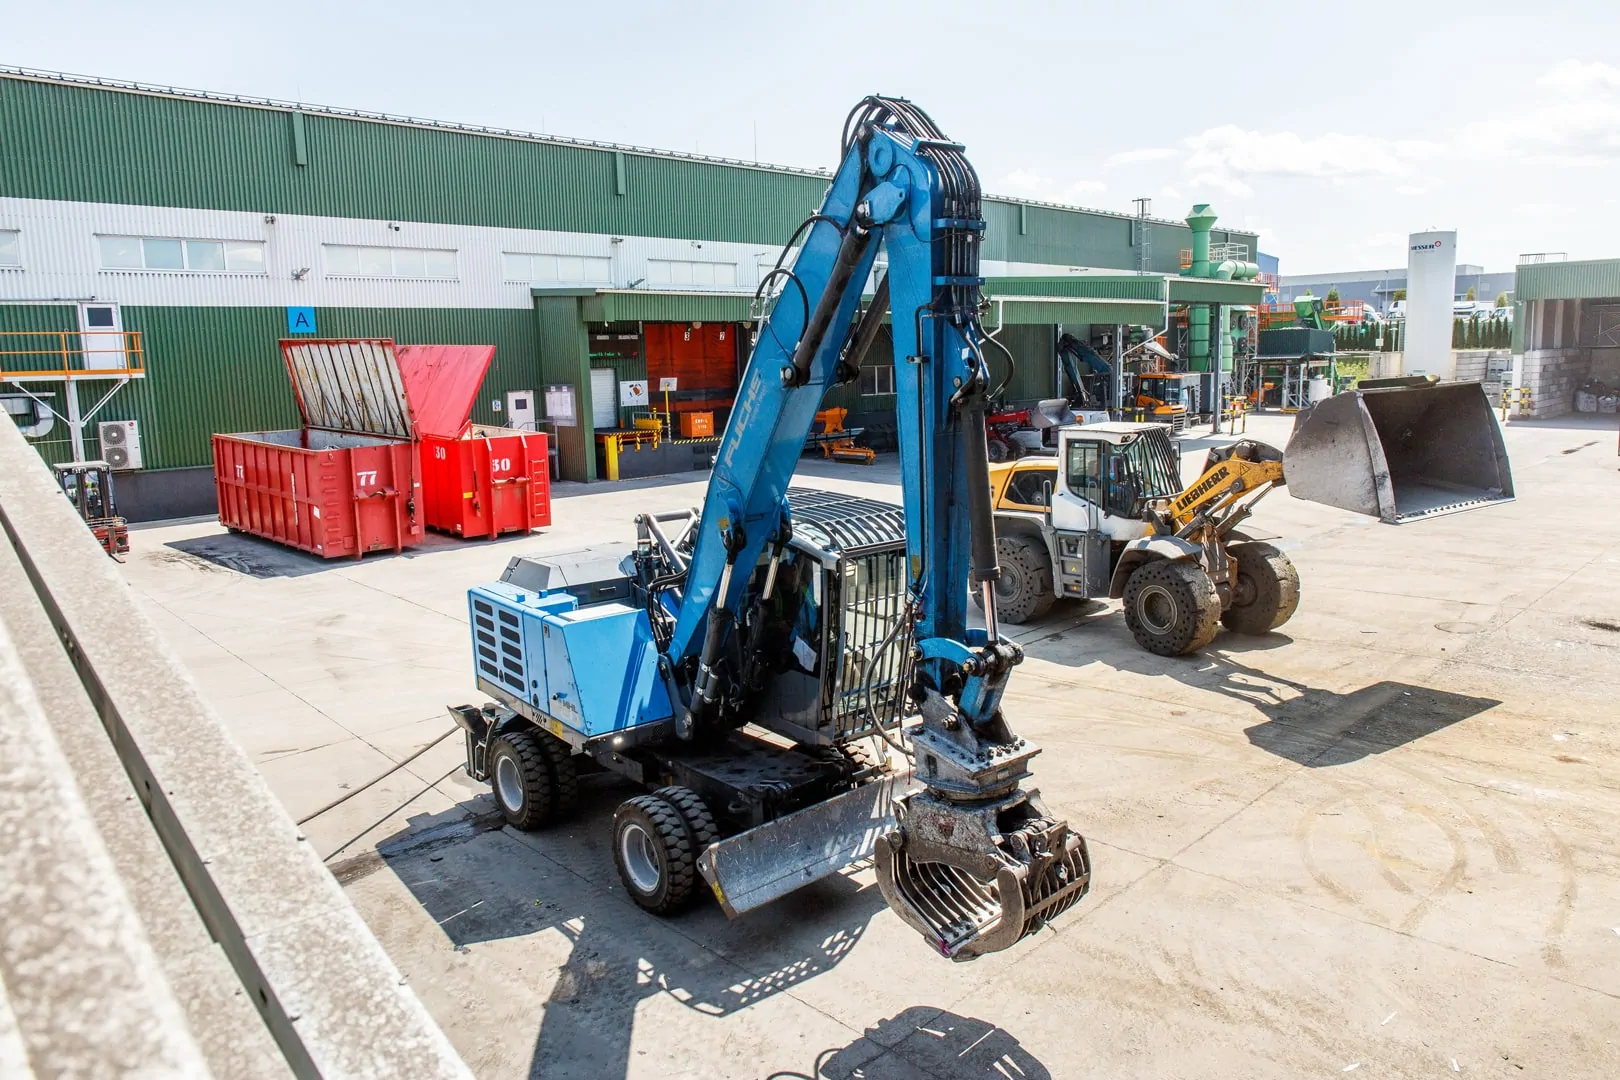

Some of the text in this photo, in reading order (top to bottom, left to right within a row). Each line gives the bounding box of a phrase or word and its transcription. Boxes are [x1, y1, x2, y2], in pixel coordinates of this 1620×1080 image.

[295, 311, 309, 328] A
[724, 367, 761, 468] FUCHS
[435, 445, 446, 461] 30
[235, 464, 244, 479] 77
[356, 470, 377, 487] 77
[1175, 466, 1231, 512] LIEBHERR
